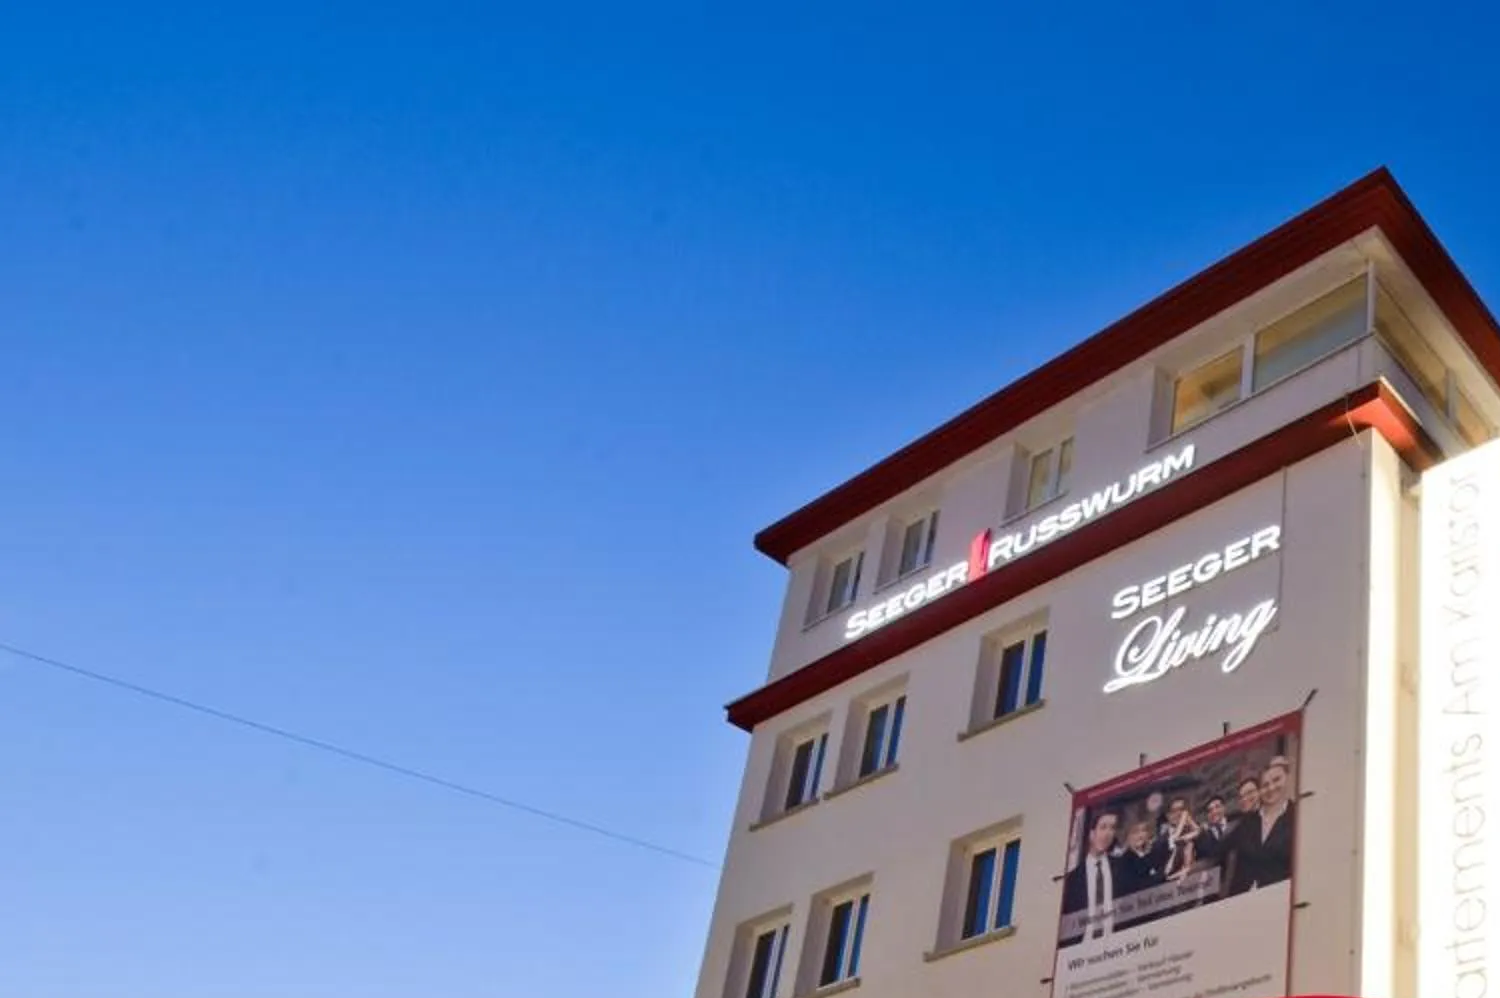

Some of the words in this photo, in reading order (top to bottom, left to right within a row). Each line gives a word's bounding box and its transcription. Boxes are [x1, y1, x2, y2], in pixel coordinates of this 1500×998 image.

[845, 559, 969, 640] SEEGER
[988, 444, 1196, 568] RUSSWURM
[1111, 525, 1281, 619] SEEGER
[1103, 599, 1278, 693] Living
[1441, 637, 1486, 717] Am
